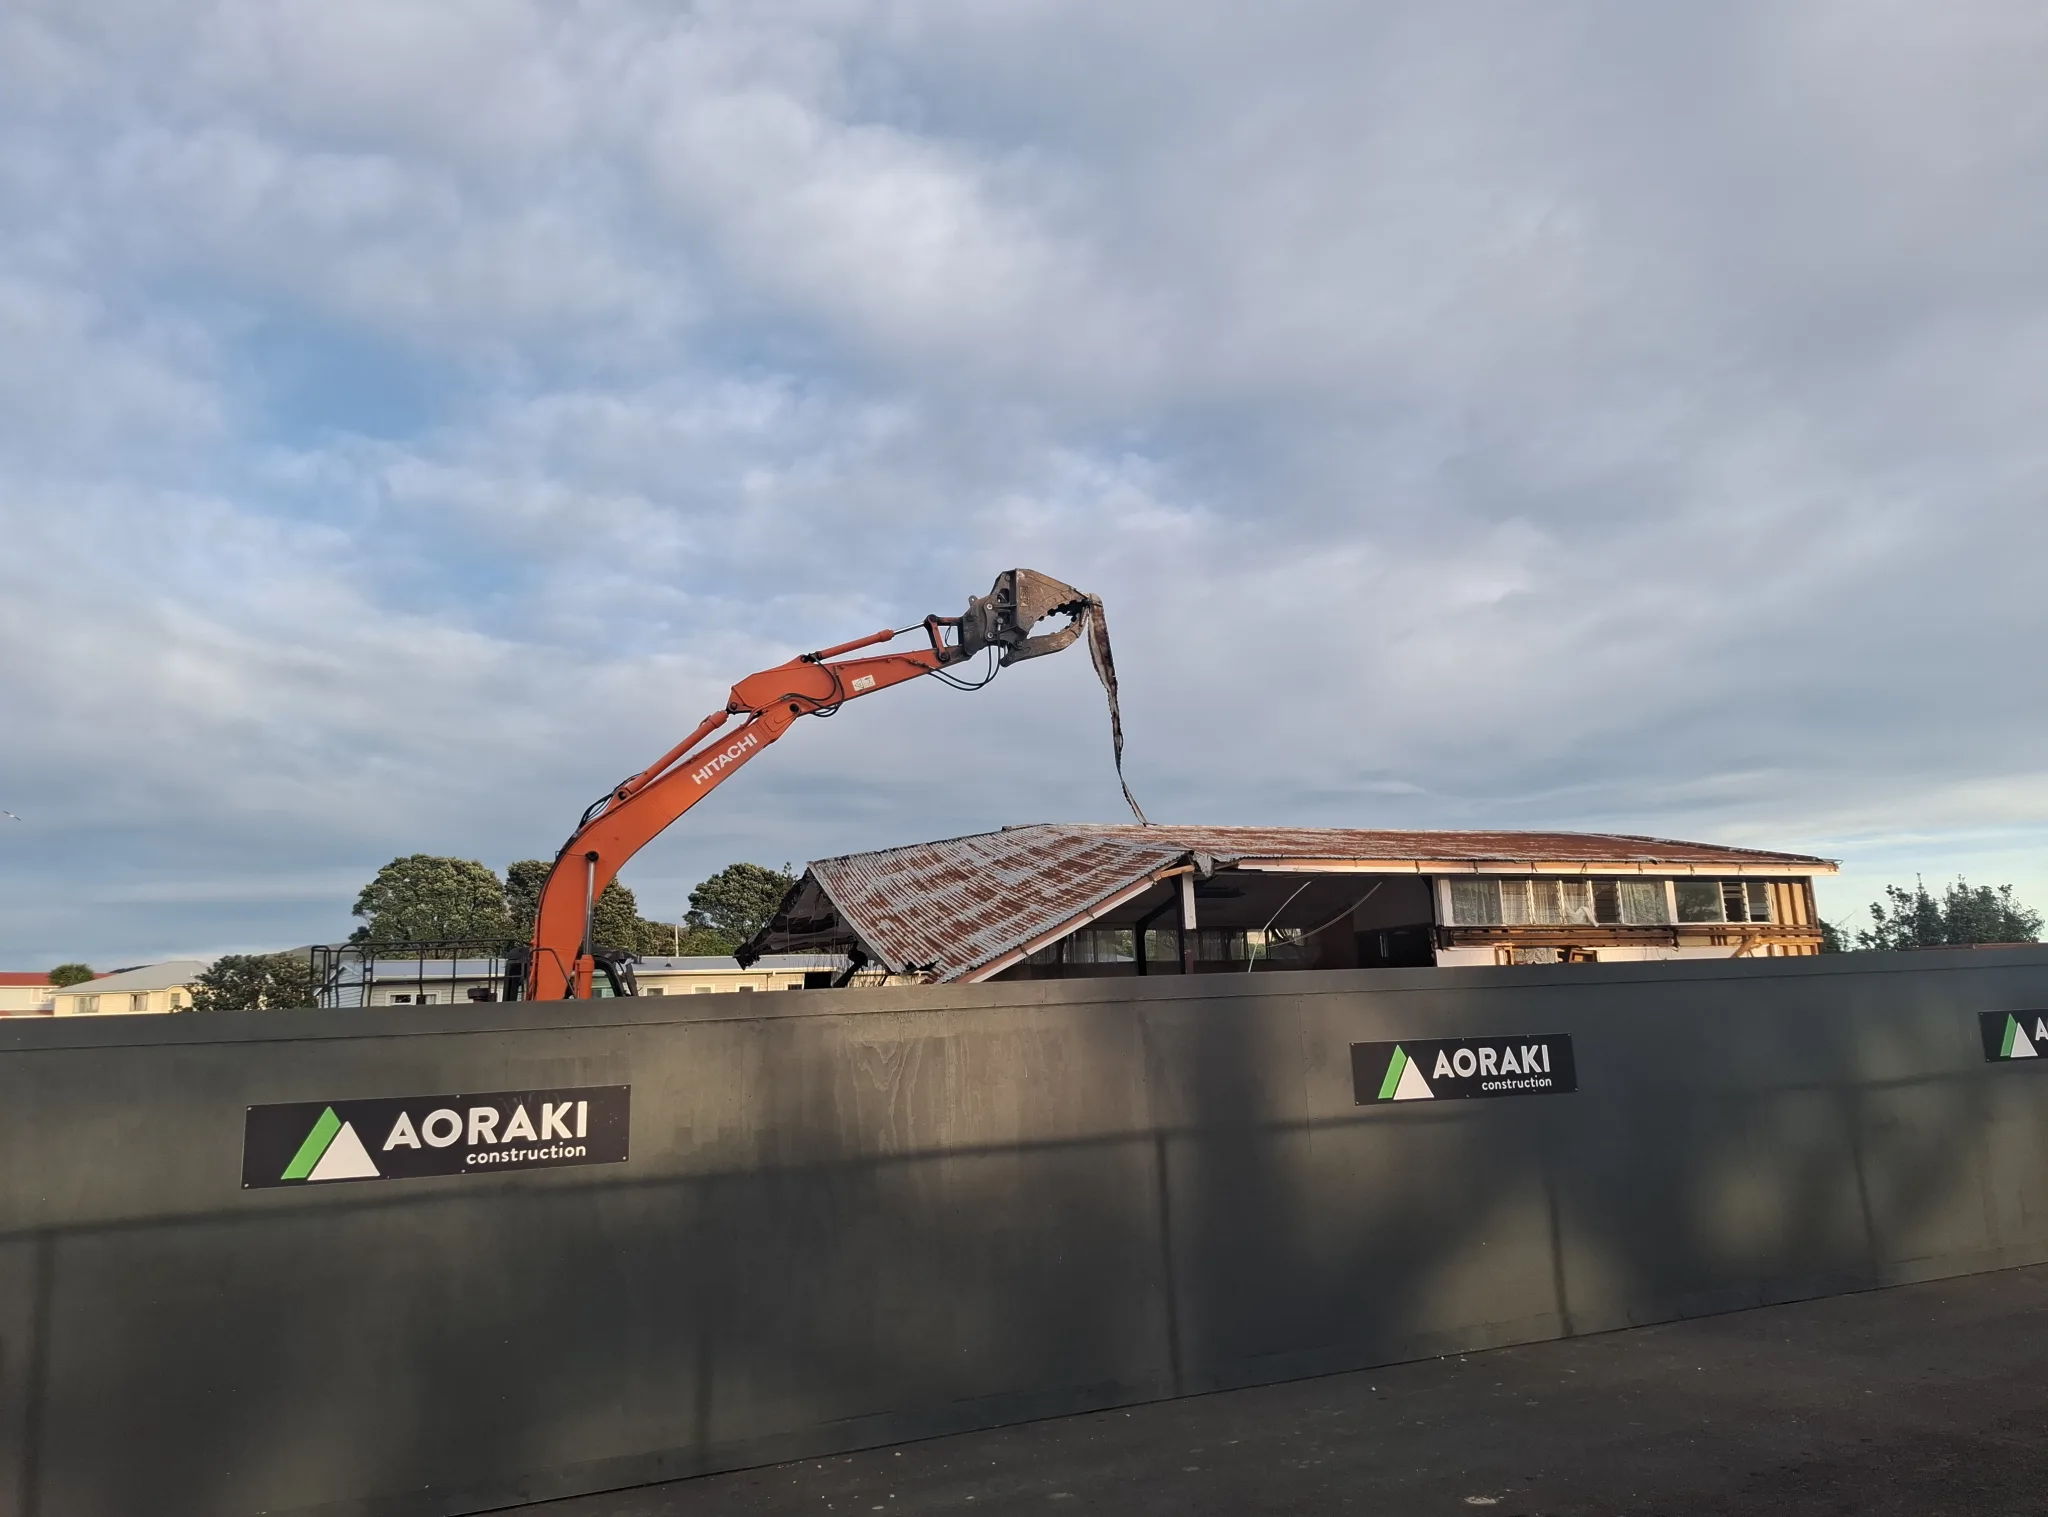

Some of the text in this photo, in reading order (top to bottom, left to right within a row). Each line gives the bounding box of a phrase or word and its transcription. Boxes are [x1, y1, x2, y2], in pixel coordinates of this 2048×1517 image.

[692, 732, 758, 785] HITACHI
[1432, 1044, 1551, 1079] AORAKI
[1481, 1074, 1552, 1091] construction
[382, 1100, 588, 1151] AORAKI
[466, 1141, 587, 1165] construction
